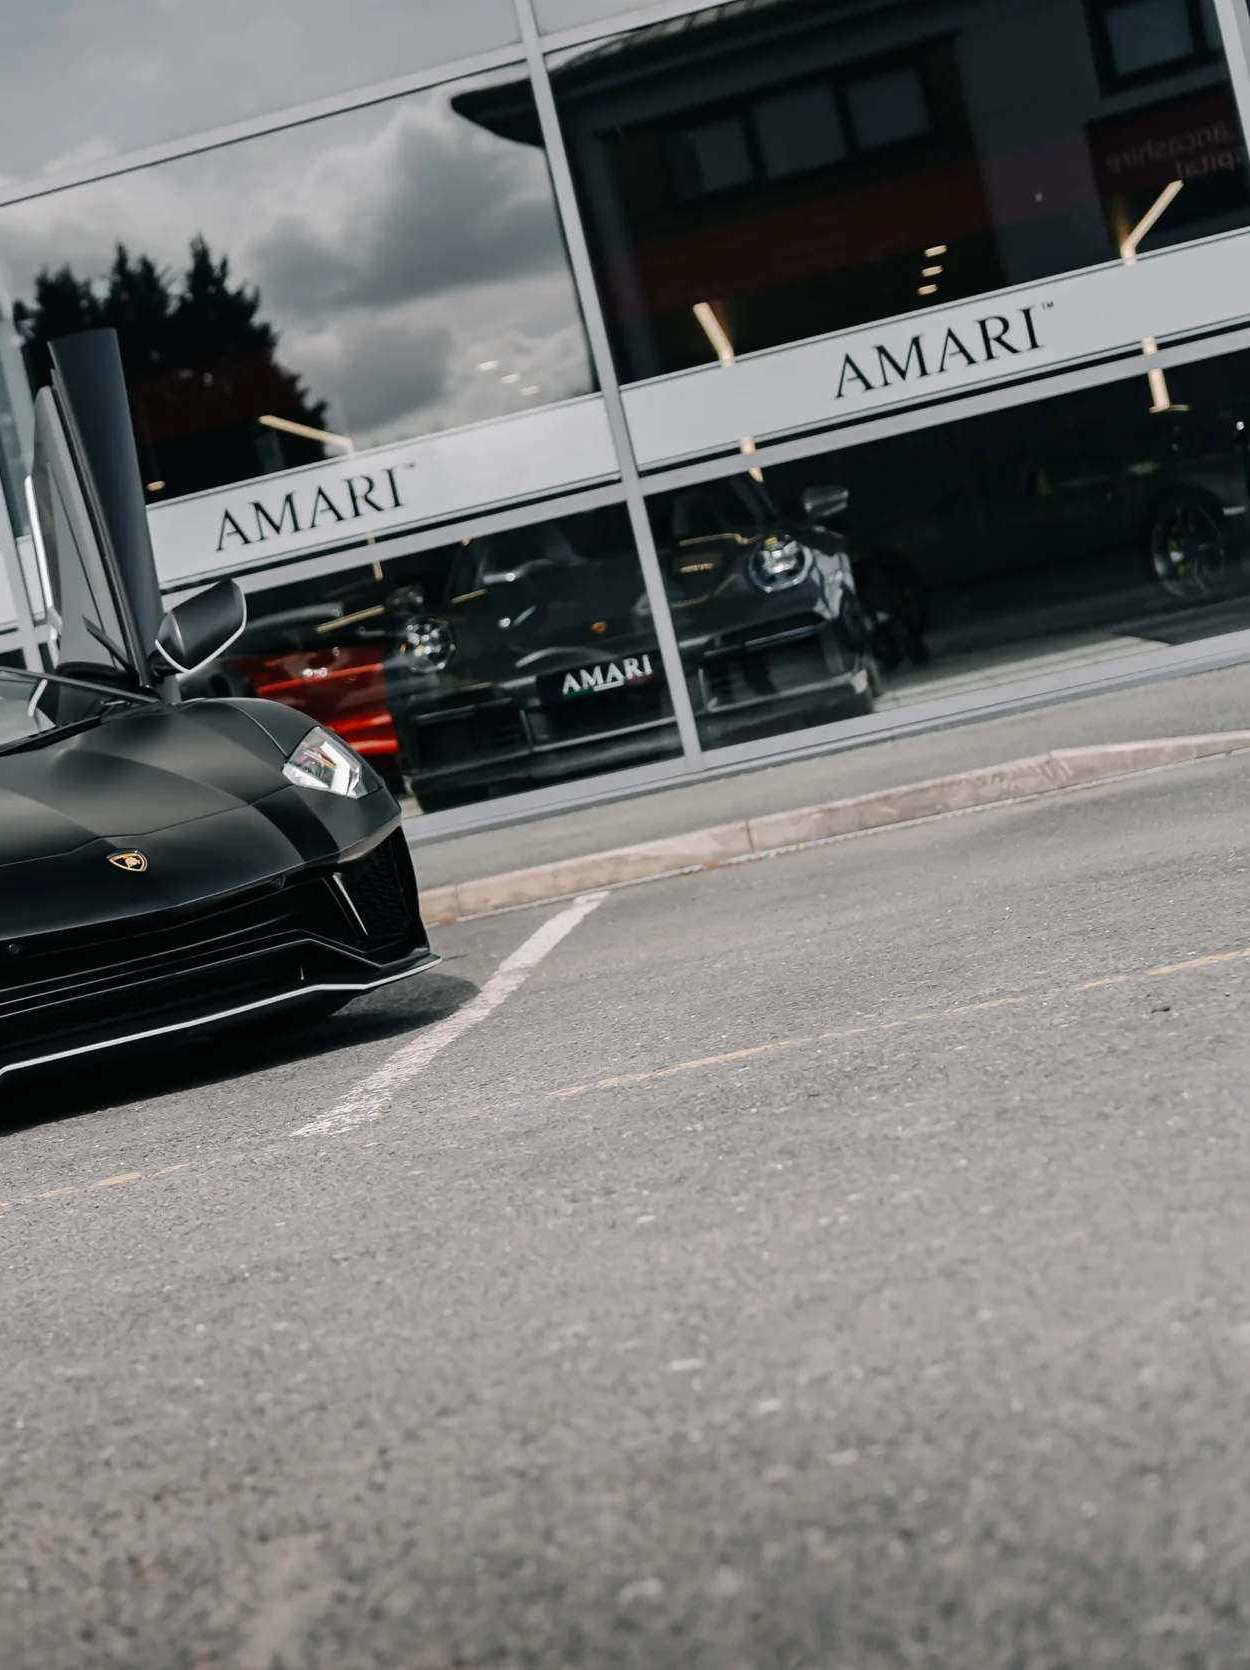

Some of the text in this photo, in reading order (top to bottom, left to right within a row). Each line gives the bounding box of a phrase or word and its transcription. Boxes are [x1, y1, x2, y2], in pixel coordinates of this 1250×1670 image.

[834, 305, 1044, 398] AMARI
[215, 467, 407, 553] AMARI
[562, 654, 653, 695] AMARI
